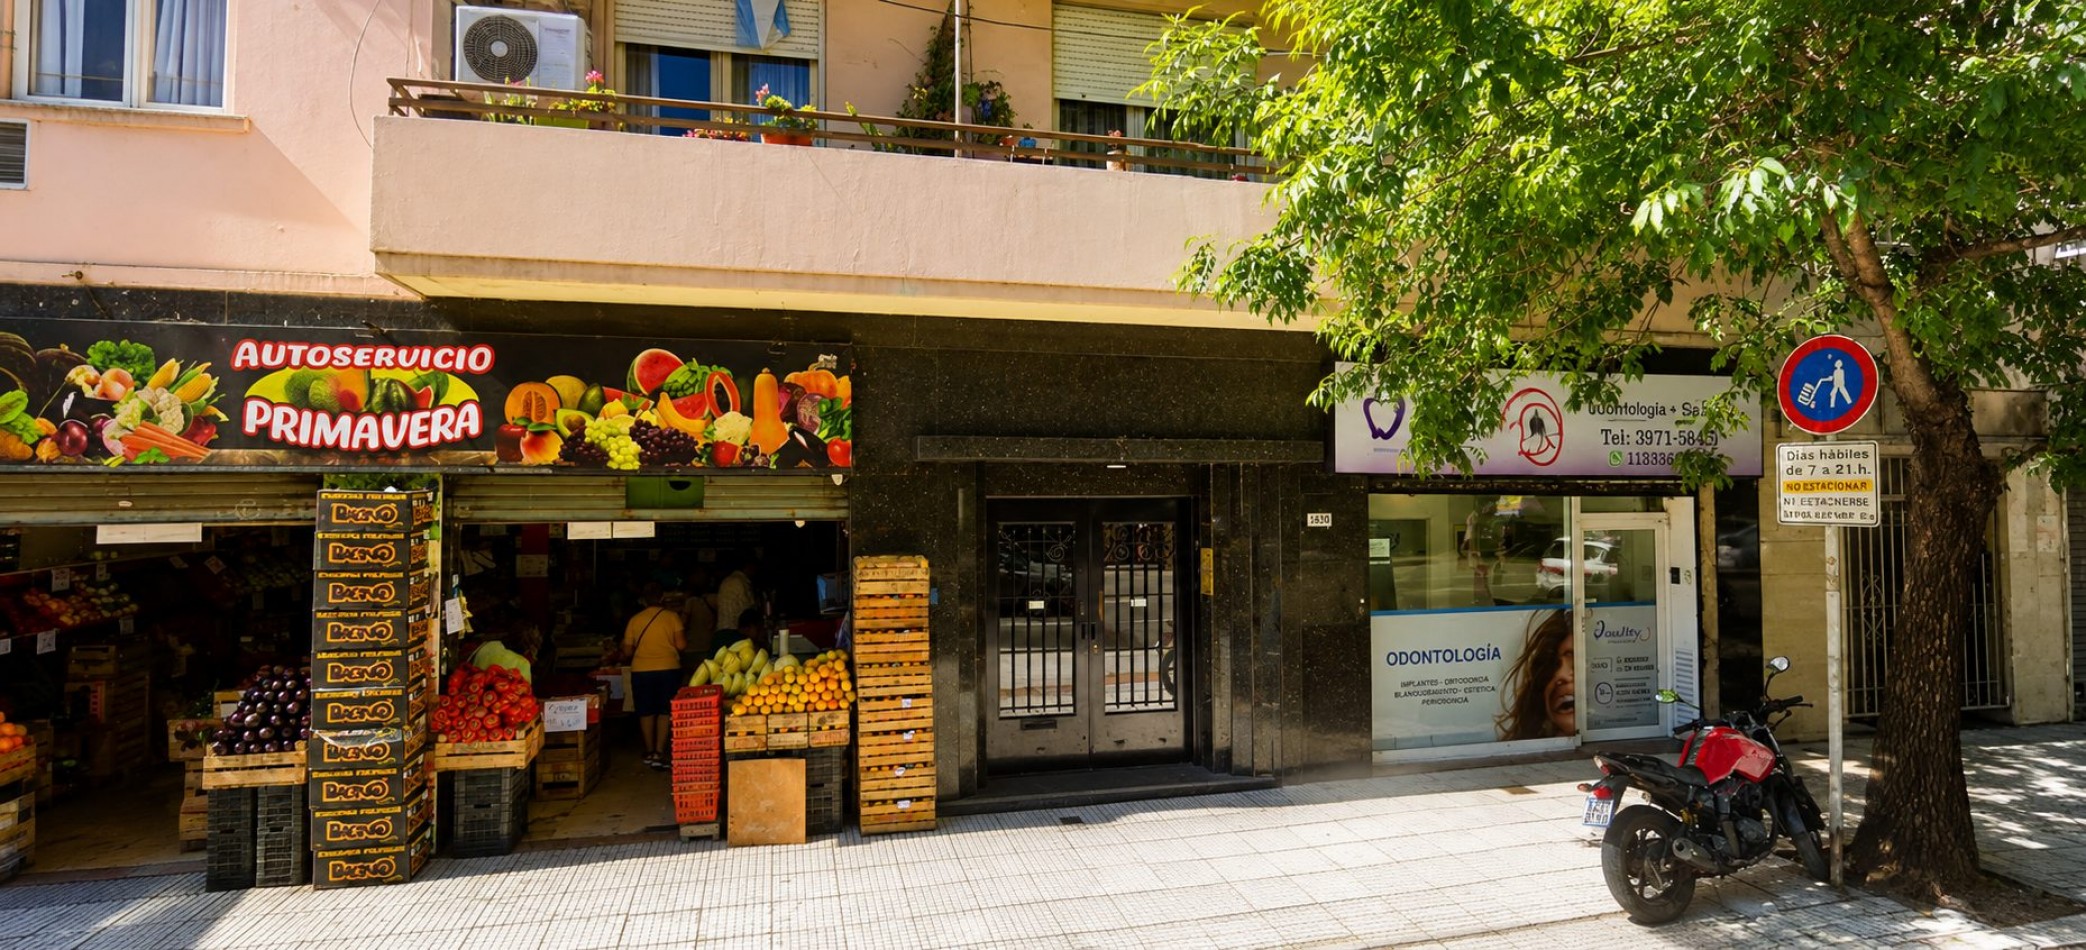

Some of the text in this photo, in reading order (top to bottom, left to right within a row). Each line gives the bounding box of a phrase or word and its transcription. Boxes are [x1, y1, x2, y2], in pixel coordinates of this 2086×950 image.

[232, 340, 494, 373] AUTOSERVICIO
[244, 399, 481, 450] PRIMAVERA
[1785, 465, 1803, 476] de
[1807, 464, 1817, 476] 7
[1821, 466, 1830, 475] a
[1786, 481, 1868, 491] NO ESTACIONAR
[1386, 643, 1502, 667] ODONTOLOGÍA
